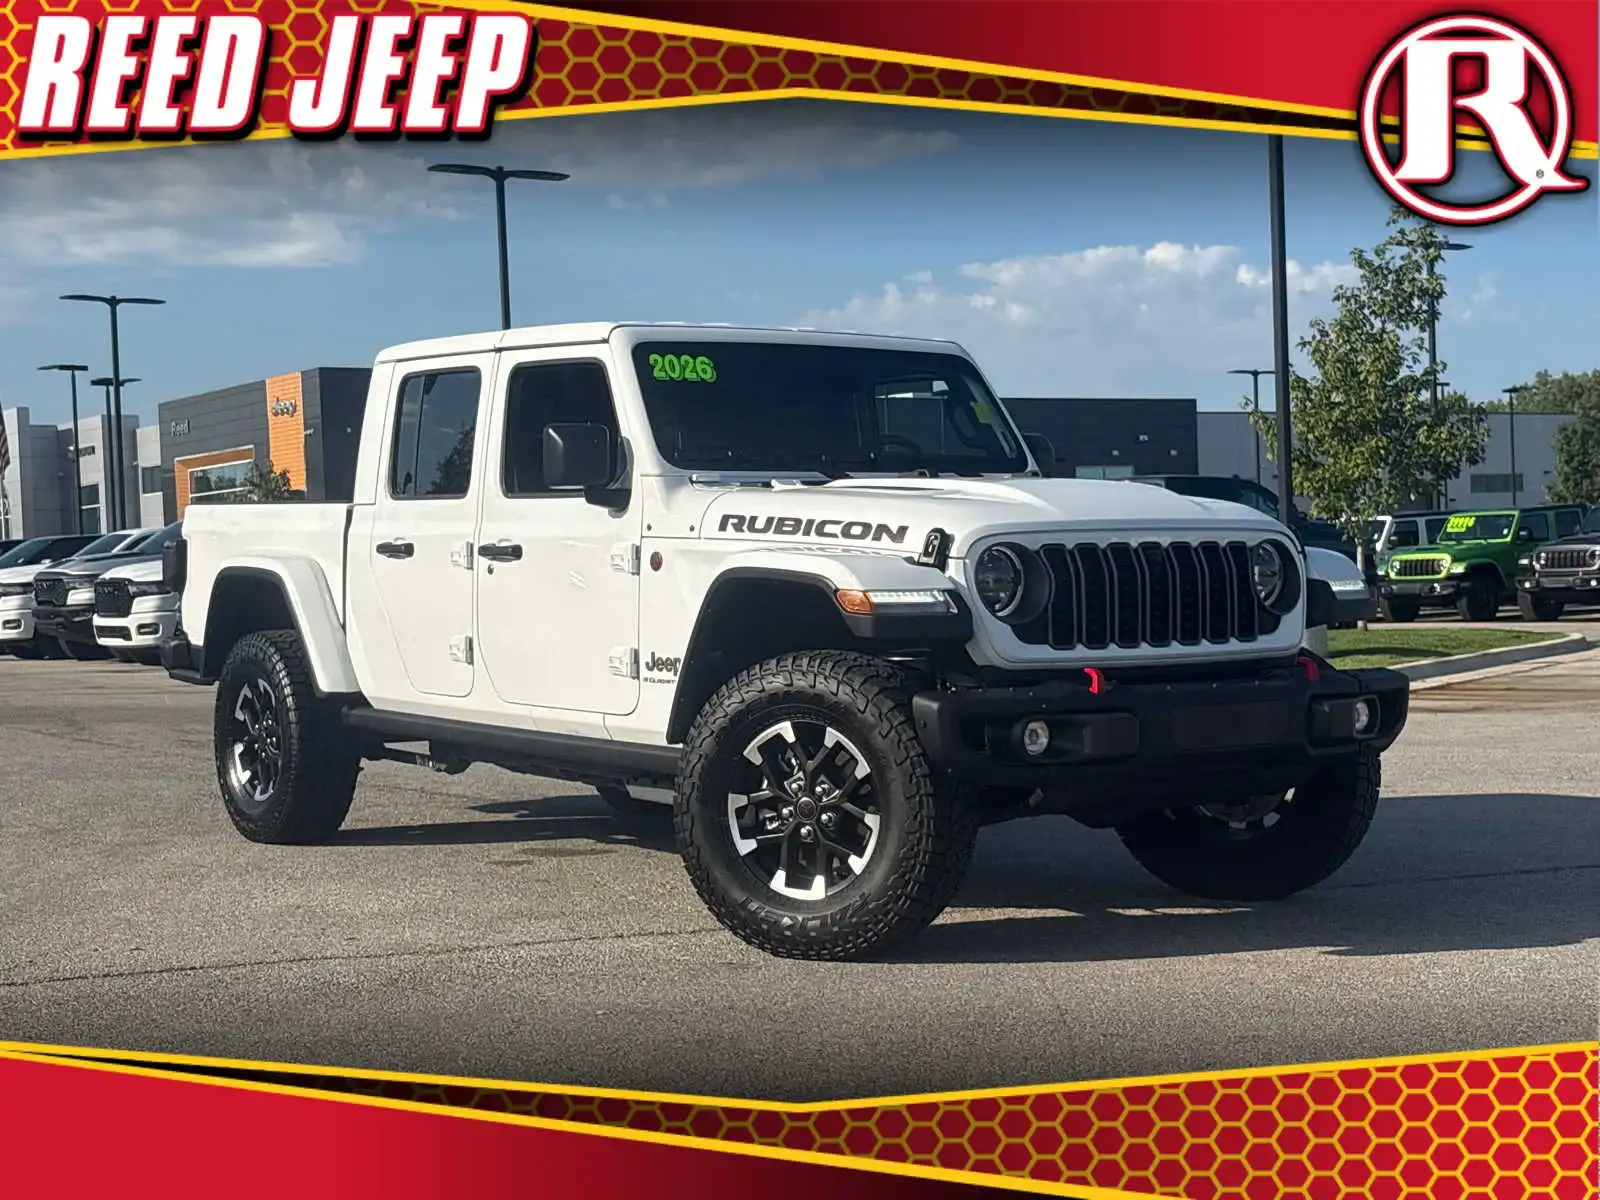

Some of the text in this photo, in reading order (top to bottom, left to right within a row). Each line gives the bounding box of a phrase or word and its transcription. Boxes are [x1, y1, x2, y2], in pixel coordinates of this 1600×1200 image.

[648, 353, 717, 383] 2026
[271, 397, 298, 418] Jeep
[170, 417, 191, 437] Reed
[717, 513, 910, 544] RUBICON
[645, 651, 682, 677] Jeep
